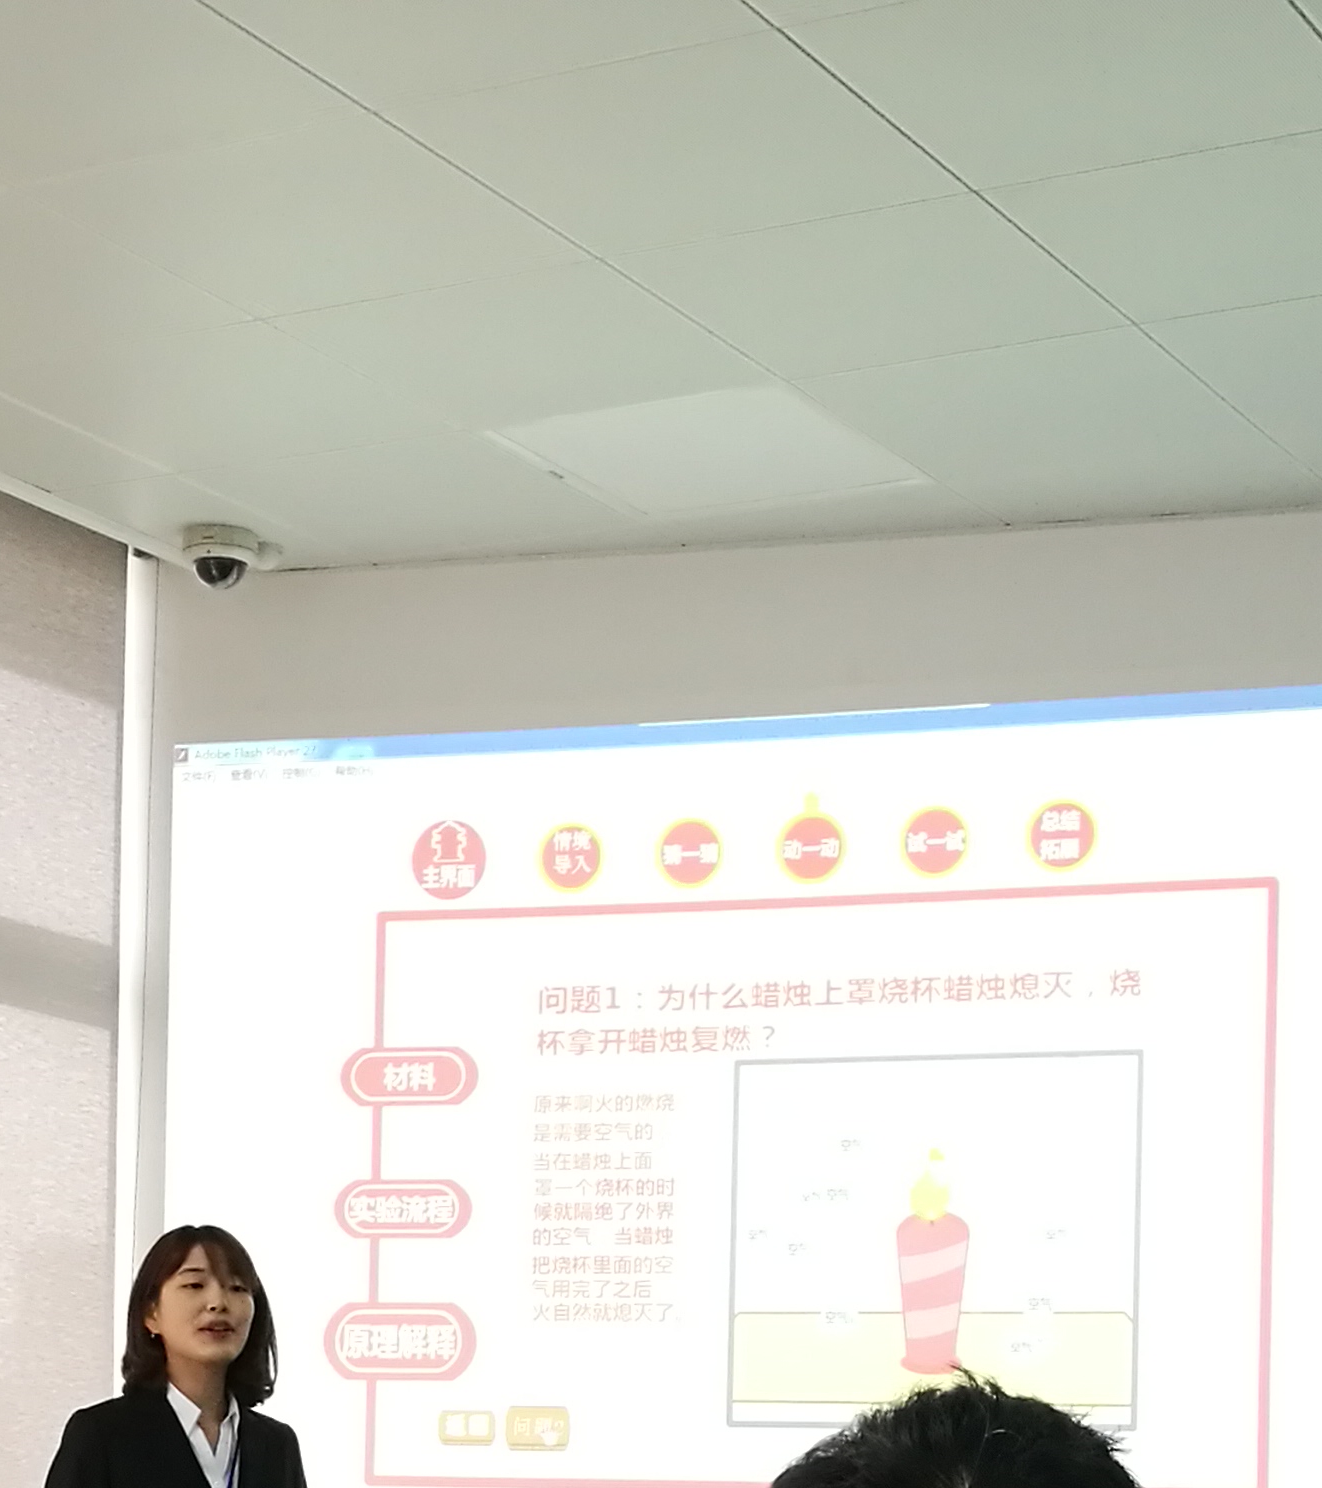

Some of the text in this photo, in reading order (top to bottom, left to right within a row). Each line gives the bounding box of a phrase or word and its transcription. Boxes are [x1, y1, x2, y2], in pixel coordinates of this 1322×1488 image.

[194, 749, 231, 760] Adobe
[234, 748, 262, 758] Flash
[266, 747, 300, 758] Player
[421, 863, 476, 889] 主界面
[552, 854, 592, 876] 导入
[382, 1062, 437, 1092] 材料
[533, 1151, 653, 1171] 当在蜡烛上面
[348, 1195, 456, 1225] 实验流程
[533, 1201, 675, 1222] 候就隔绝了外界
[532, 1255, 674, 1275] 把烧杯里面的空
[341, 1323, 457, 1362] 原理解释
